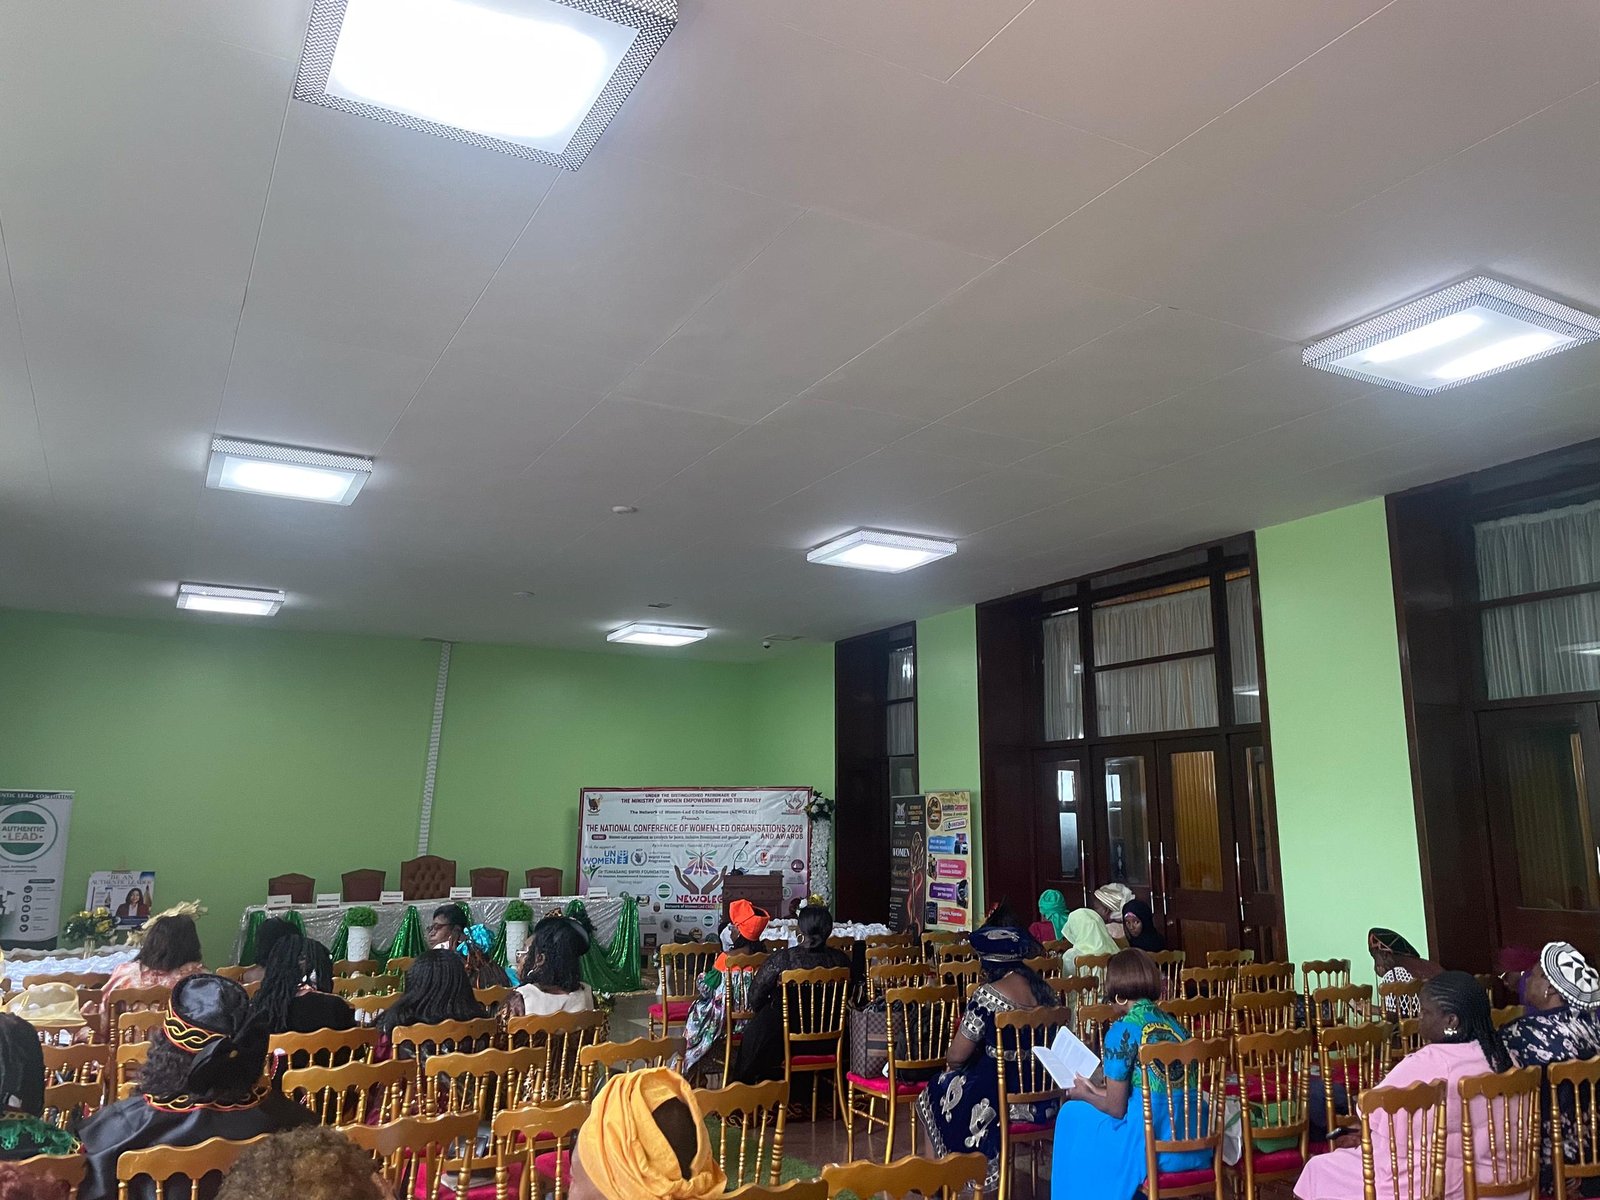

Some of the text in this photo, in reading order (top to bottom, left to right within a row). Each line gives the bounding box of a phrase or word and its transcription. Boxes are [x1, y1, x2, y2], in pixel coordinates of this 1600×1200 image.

[586, 824, 598, 832] THE
[600, 824, 631, 832] NATIONAL
[634, 824, 677, 832] CONFERENCE
[679, 824, 688, 832] OF
[690, 824, 729, 832] WOMEN-LED
[732, 824, 785, 832] ORGANISATIONS
[892, 848, 910, 856] WOMEN
